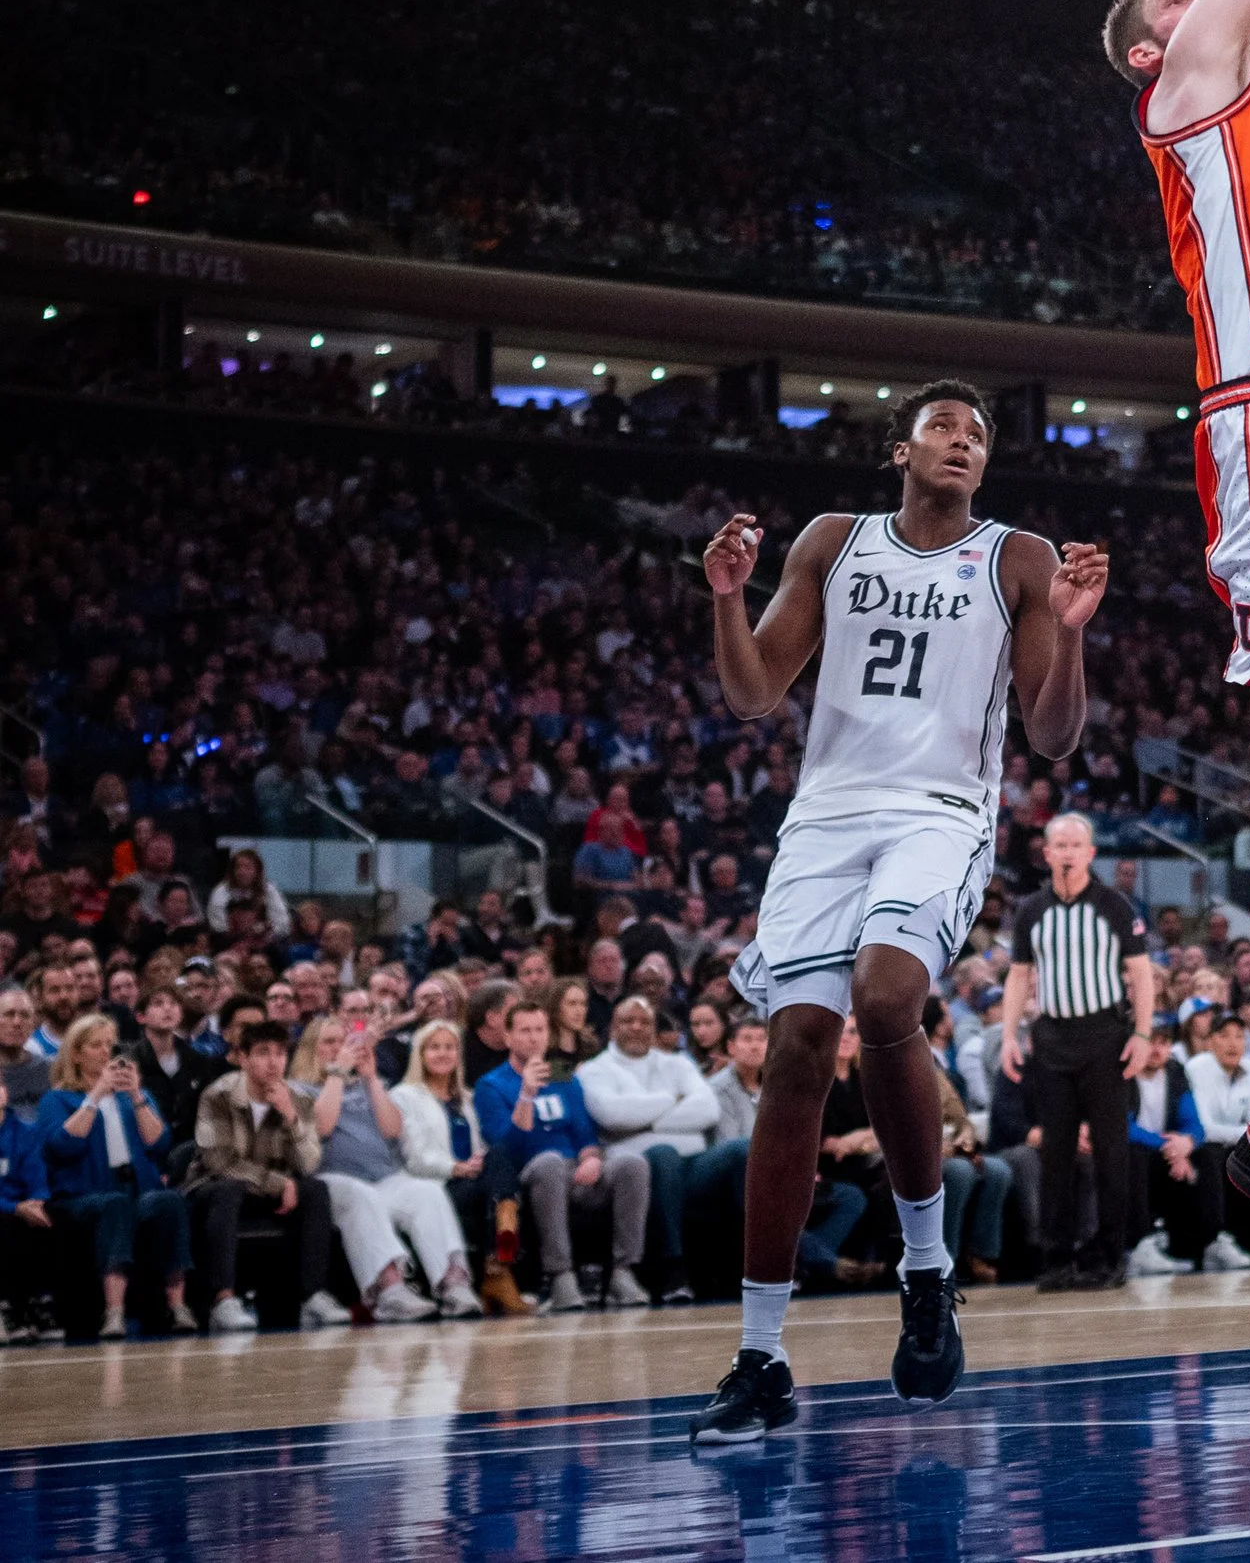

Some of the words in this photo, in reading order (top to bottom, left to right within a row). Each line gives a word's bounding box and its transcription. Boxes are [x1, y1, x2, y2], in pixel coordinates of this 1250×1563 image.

[64, 236, 149, 272] SUITE
[159, 250, 247, 283] LEVEL
[847, 571, 972, 622] Duke
[861, 628, 930, 699] 21
